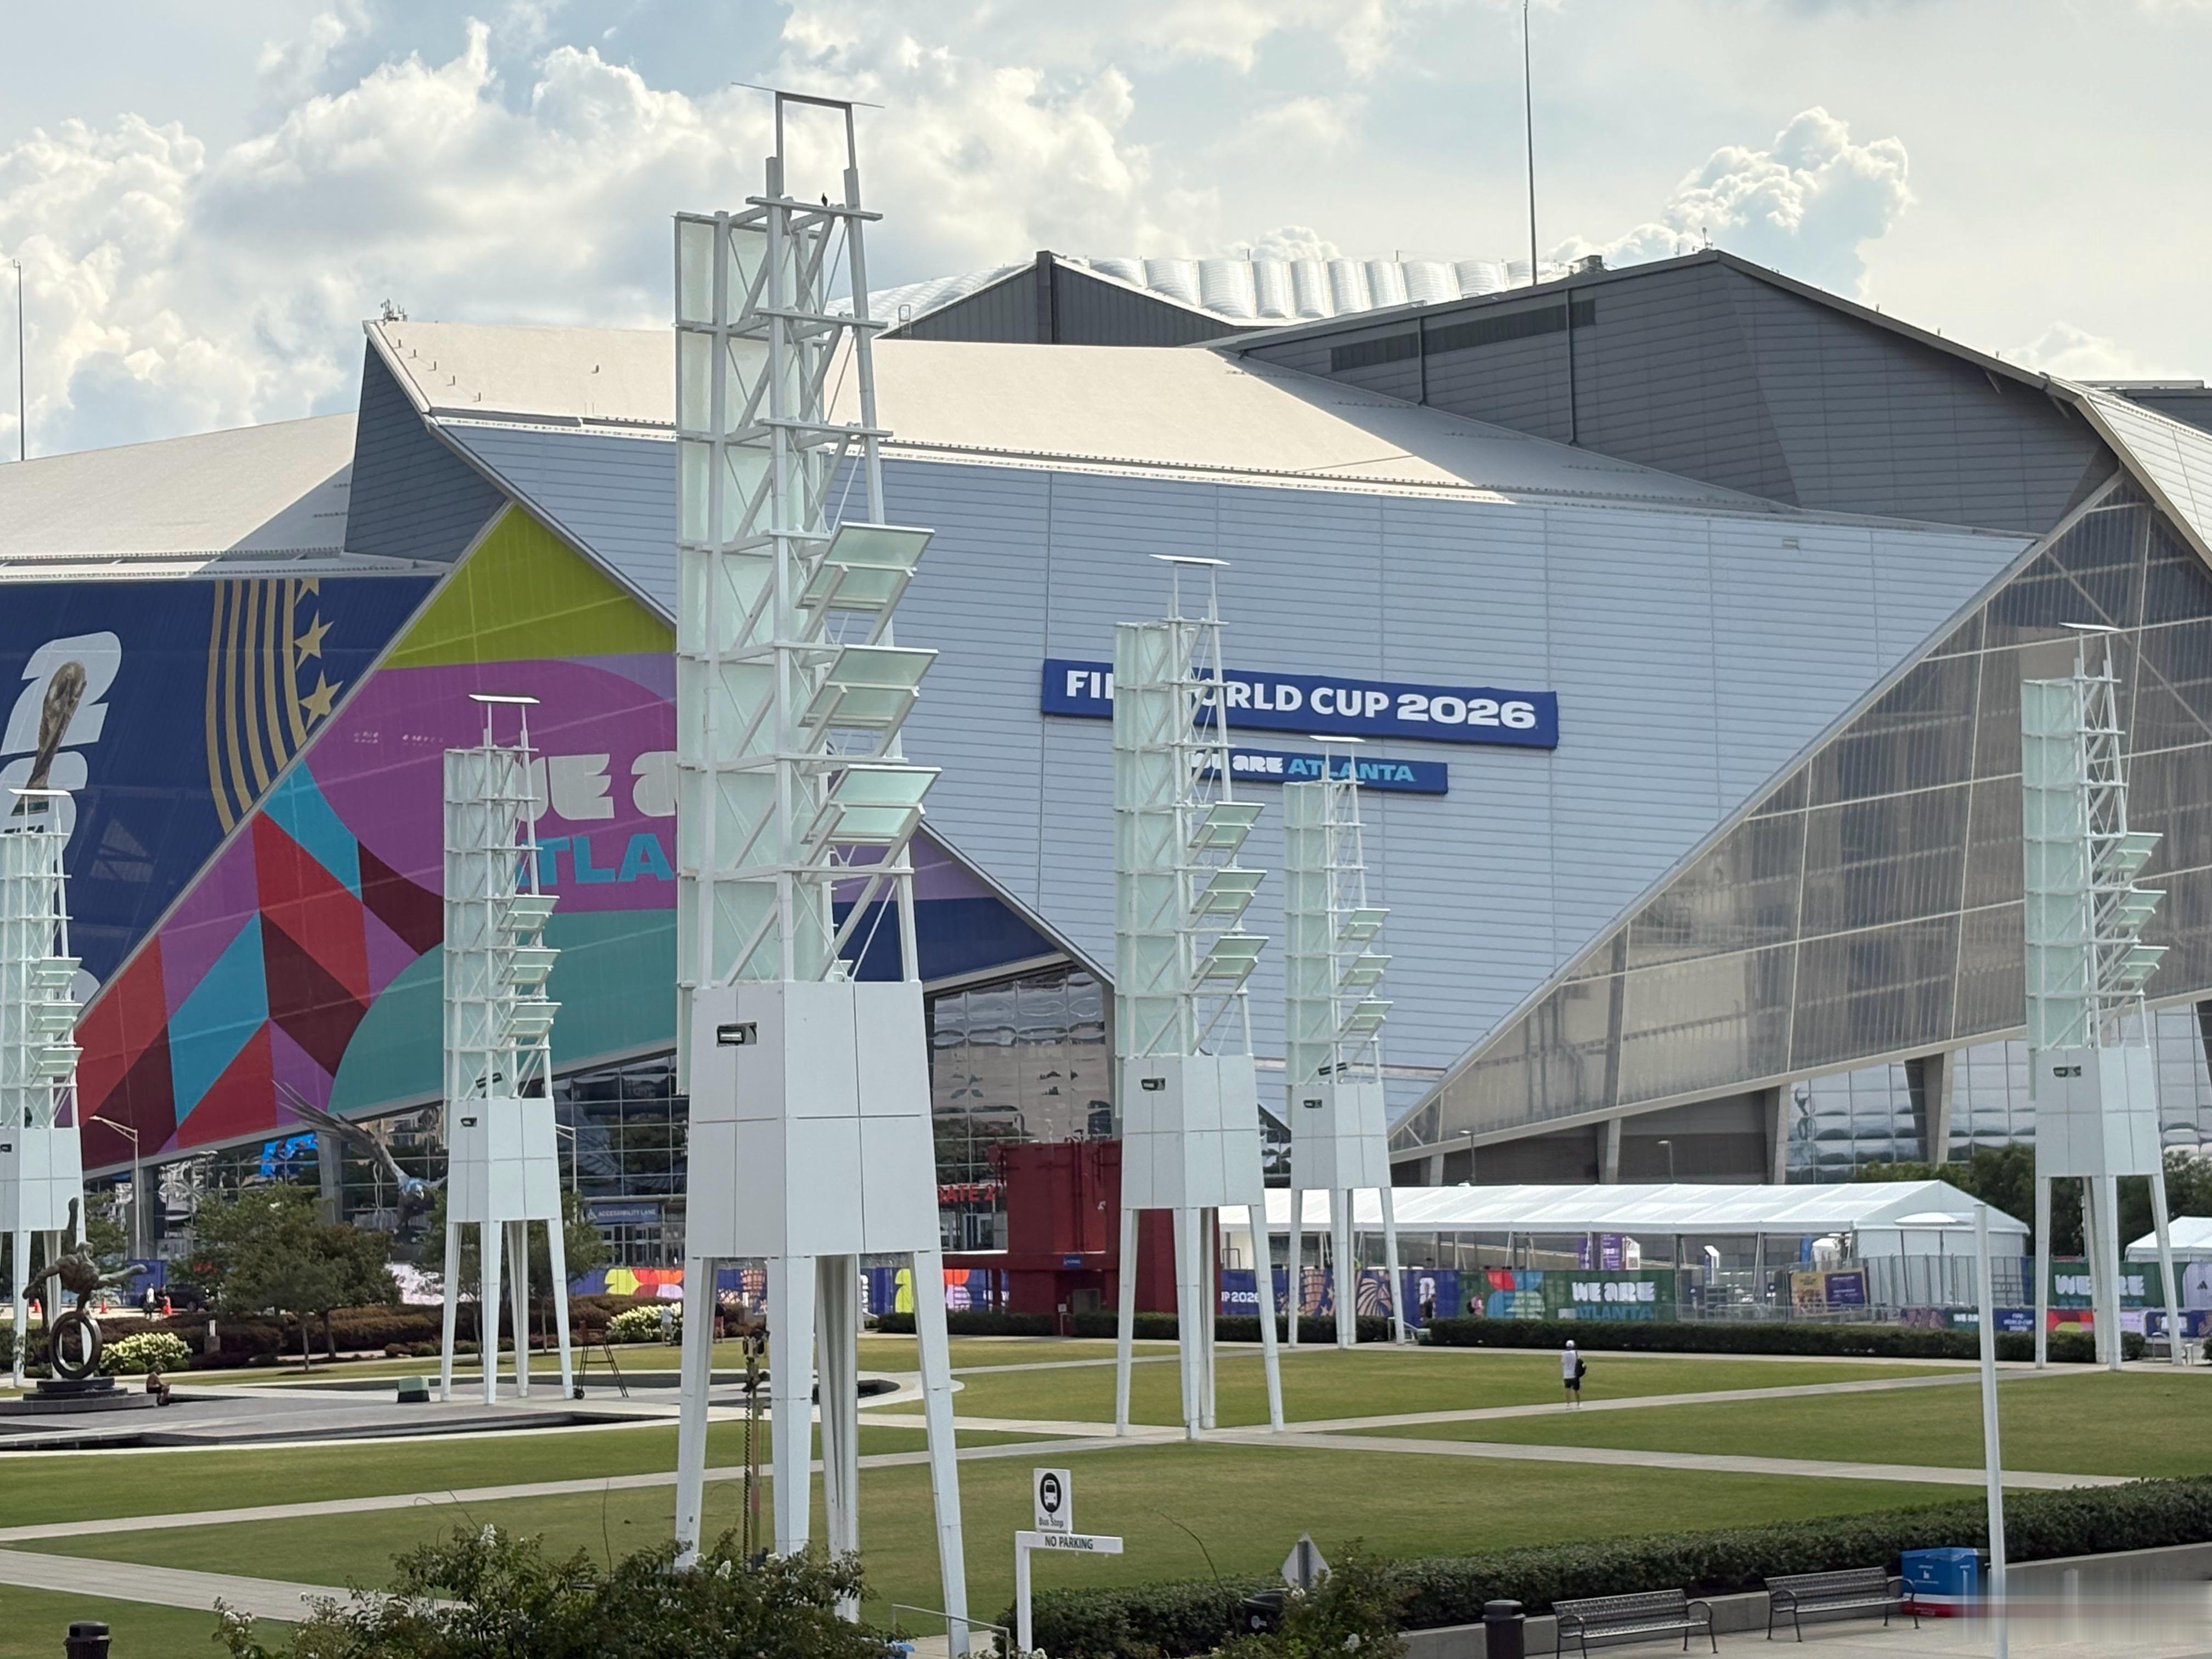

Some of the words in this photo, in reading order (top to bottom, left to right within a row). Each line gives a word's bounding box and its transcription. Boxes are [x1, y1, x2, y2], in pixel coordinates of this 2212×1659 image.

[1311, 687, 1389, 718] CUP
[1397, 693, 1536, 729] 2026
[1572, 1282, 1601, 1302] WE
[2055, 1274, 2092, 1295] WE
[1576, 1305, 1654, 1320] ATLANTA
[1039, 1516, 1049, 1526] Bus
[1050, 1516, 1064, 1529] Stop
[1045, 1536, 1057, 1547] NO
[1059, 1537, 1093, 1550] PARKING
